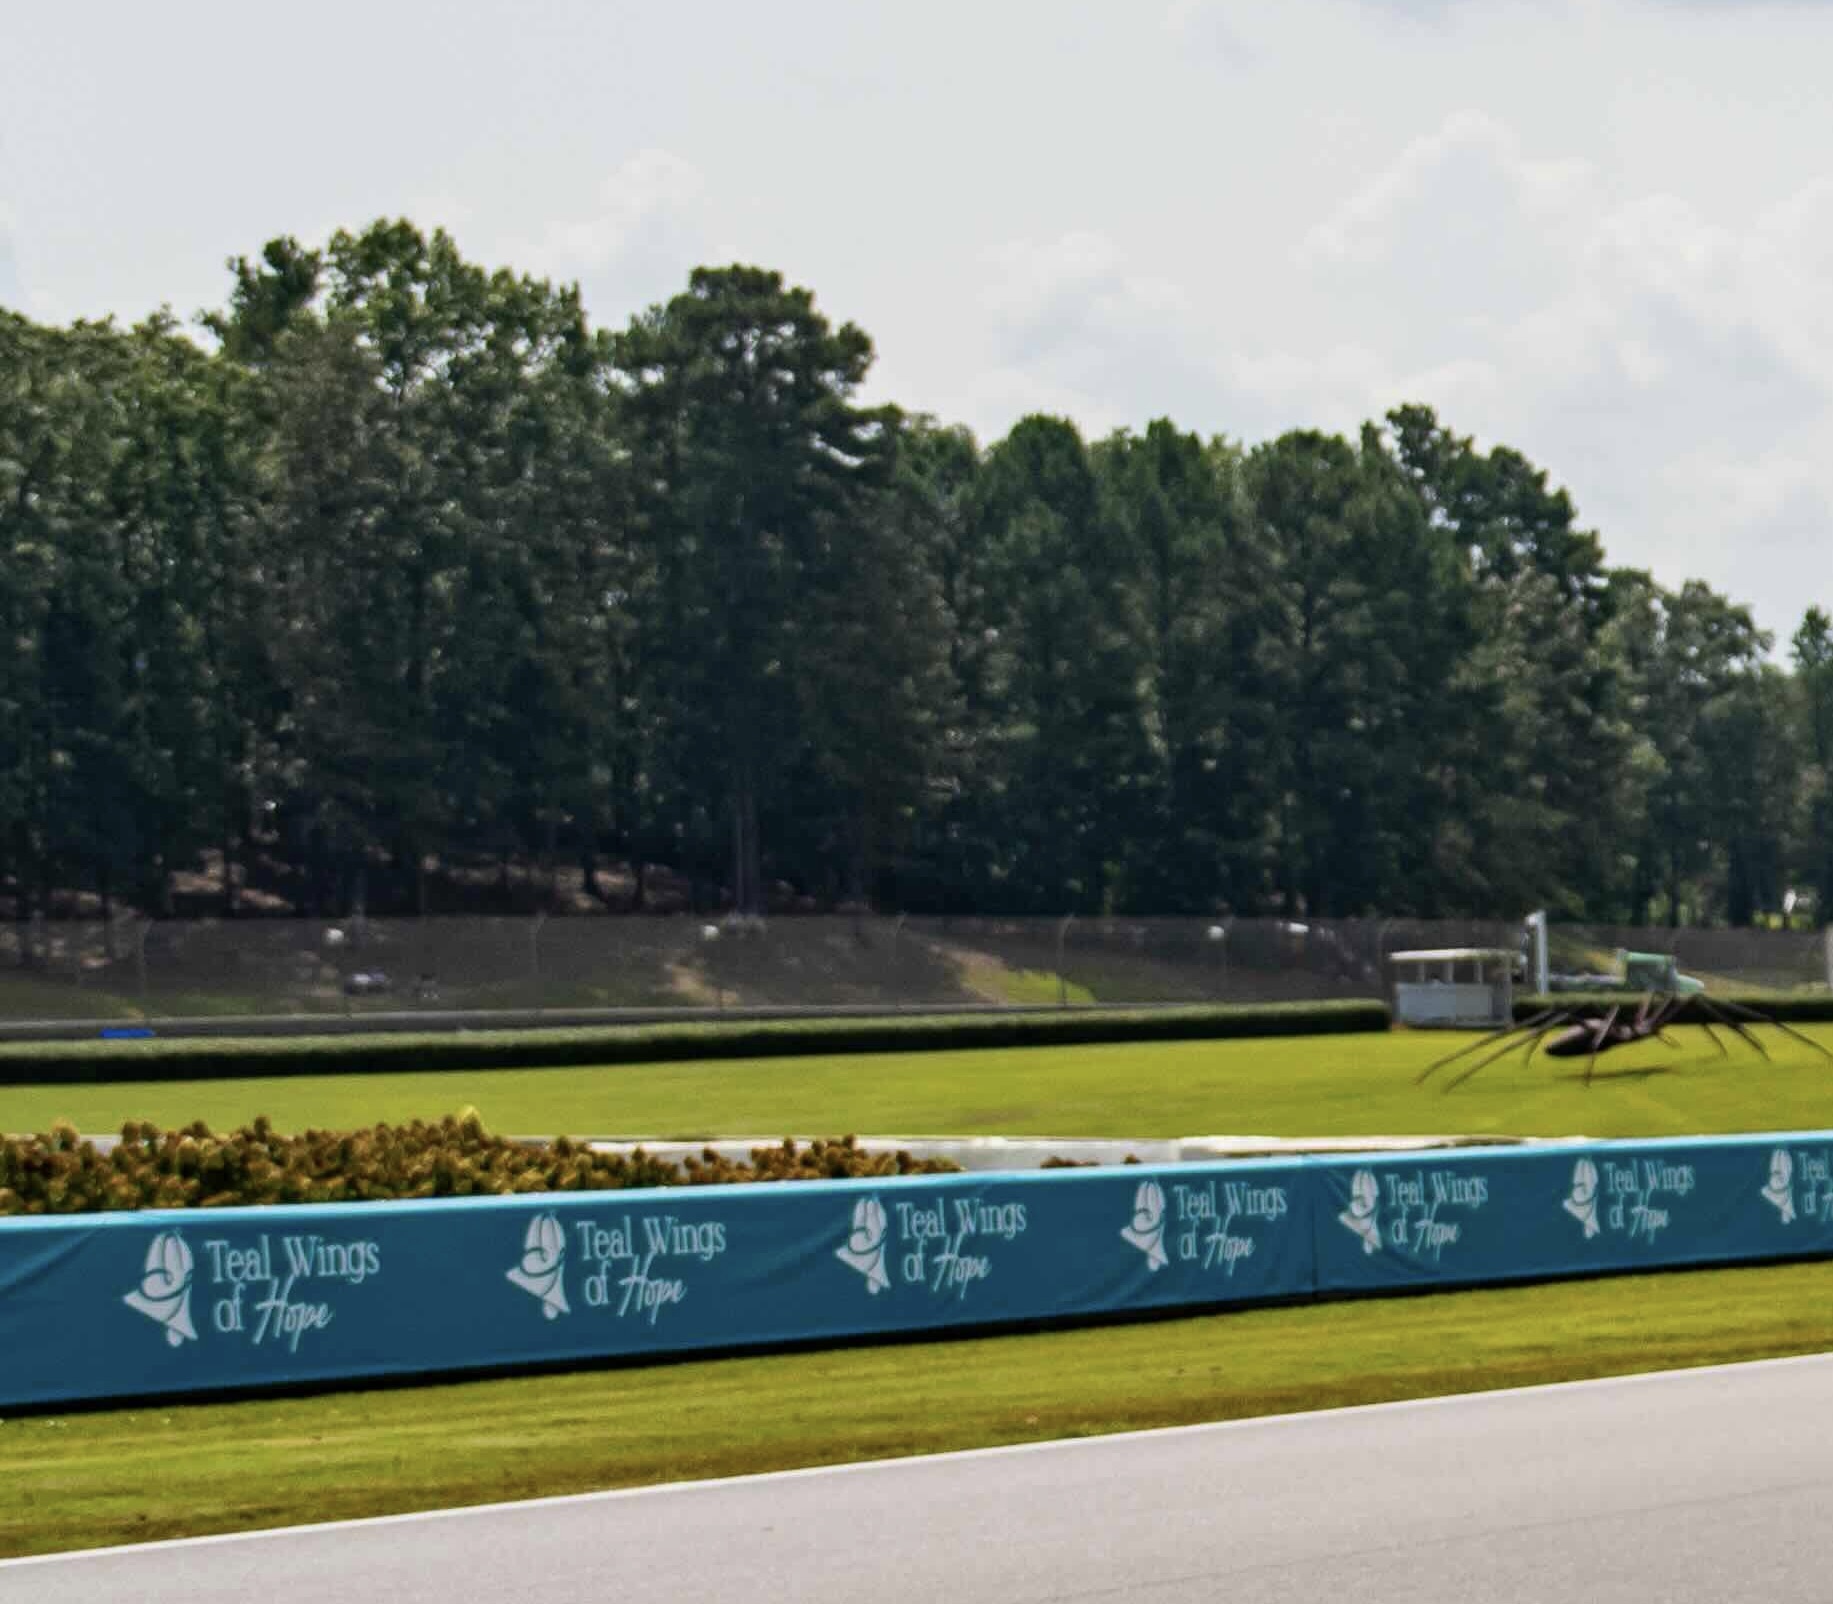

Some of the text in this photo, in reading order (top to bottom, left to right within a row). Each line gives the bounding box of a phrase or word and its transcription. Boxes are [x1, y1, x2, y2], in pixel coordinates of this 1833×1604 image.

[1604, 1158, 1695, 1196] Teal Wings
[1798, 1149, 1828, 1180] Teal
[1173, 1180, 1288, 1220] Teal Wings
[1384, 1171, 1489, 1209] Teal Wings
[1803, 1179, 1817, 1214] of
[576, 1215, 726, 1261] Teal Wings
[896, 1197, 1026, 1240] Teal Wings
[1392, 1202, 1460, 1261] of Hope
[1608, 1188, 1671, 1244] of Hope
[204, 1234, 380, 1283] Teal Wings
[904, 1234, 992, 1300] of Hope
[1180, 1218, 1257, 1276] of Hope
[584, 1251, 687, 1325] of Hope
[213, 1274, 334, 1352] of Hope
